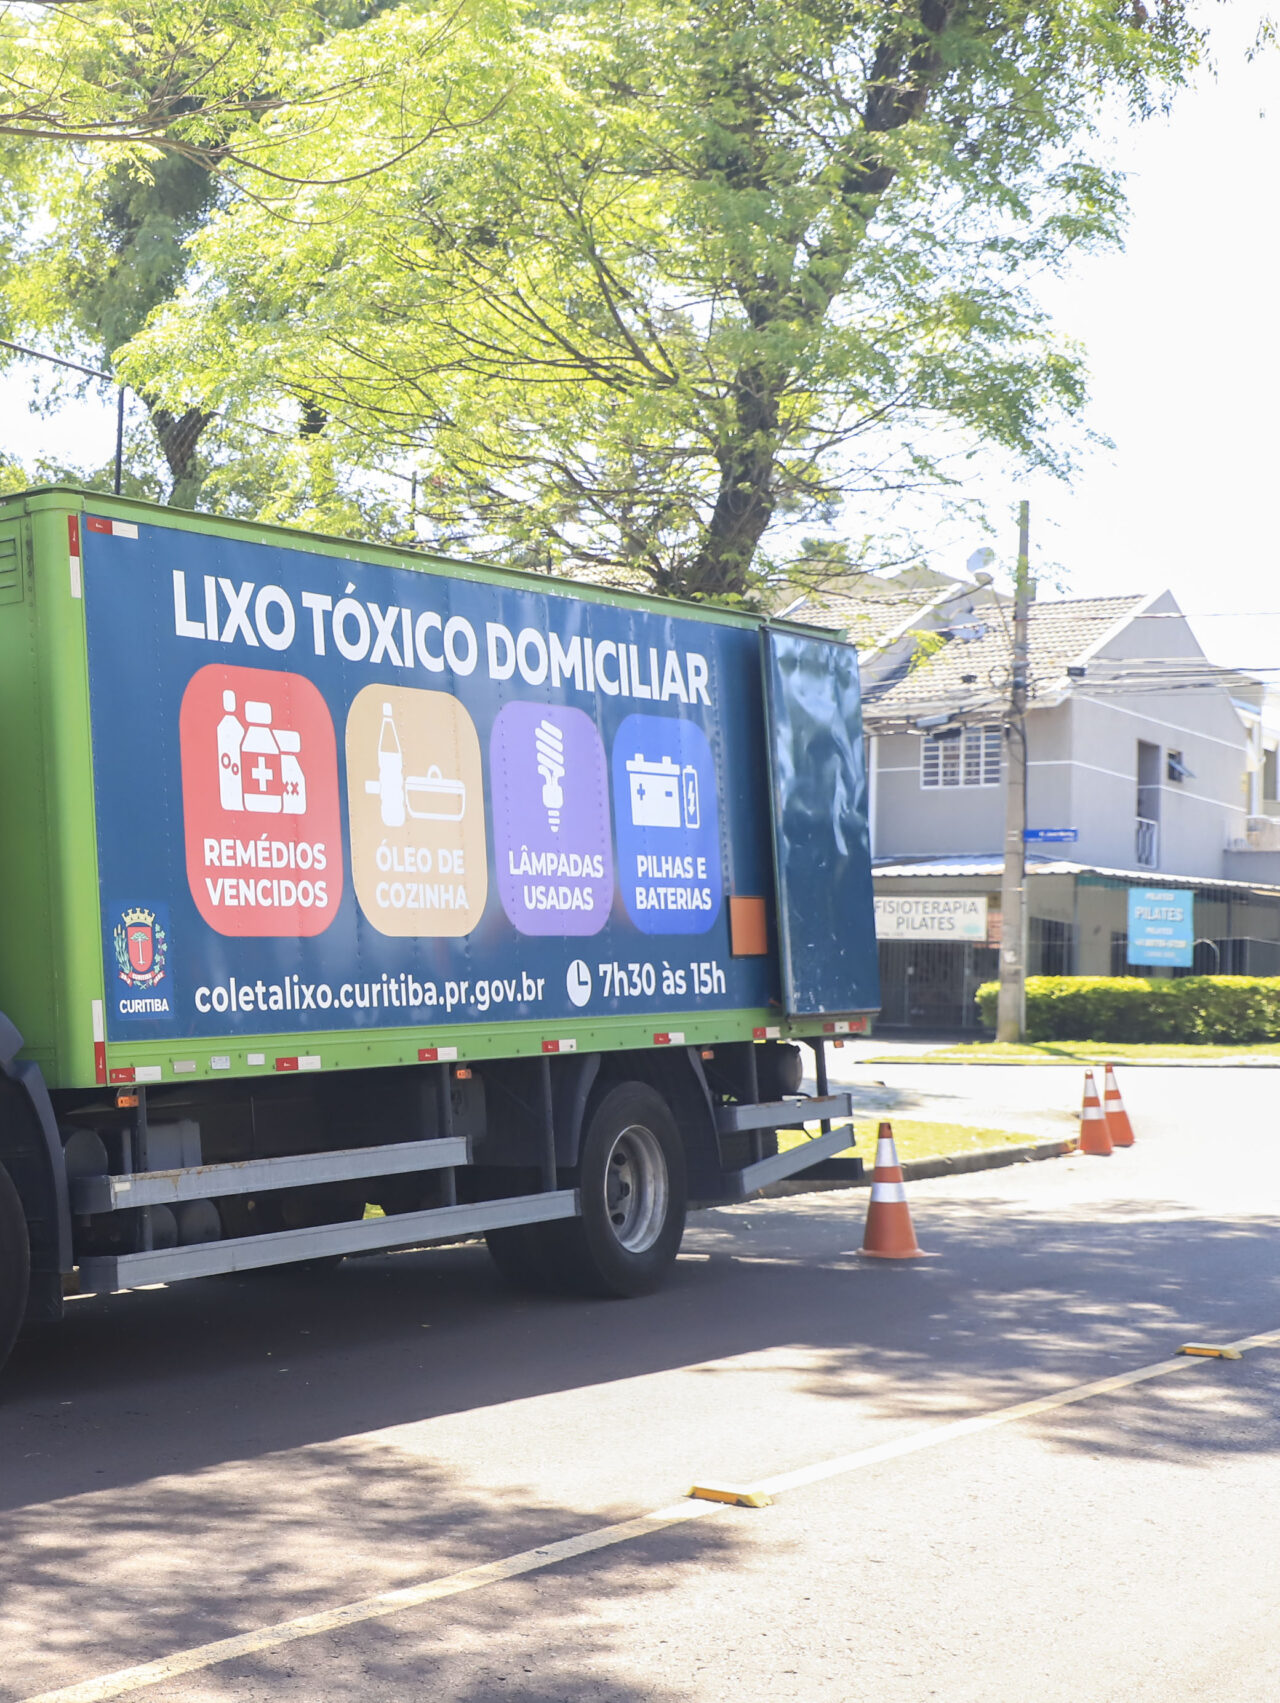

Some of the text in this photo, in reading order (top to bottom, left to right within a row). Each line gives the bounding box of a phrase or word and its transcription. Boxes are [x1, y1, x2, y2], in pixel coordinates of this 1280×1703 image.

[173, 570, 712, 706] LIXO TÓXICO DOMICILIAR
[204, 833, 327, 870] REMÉDIOS
[375, 839, 465, 875] ÓLEO DE
[509, 845, 604, 879] LÂMPADAS
[637, 855, 707, 879] PILHAS E
[205, 878, 328, 908] VENCIDOS
[375, 881, 470, 910] COZINHA
[524, 886, 594, 911] USADAS
[635, 887, 712, 911] BATERIAS
[874, 900, 979, 915] FISIOTERAPIA
[896, 916, 956, 931] PILATES
[1135, 906, 1184, 921] PILATES
[195, 971, 546, 1013] coletalixo.curitiba.pr.gov.br
[599, 960, 726, 997] 7h30 às 15h
[119, 999, 170, 1014] CURITIBA
